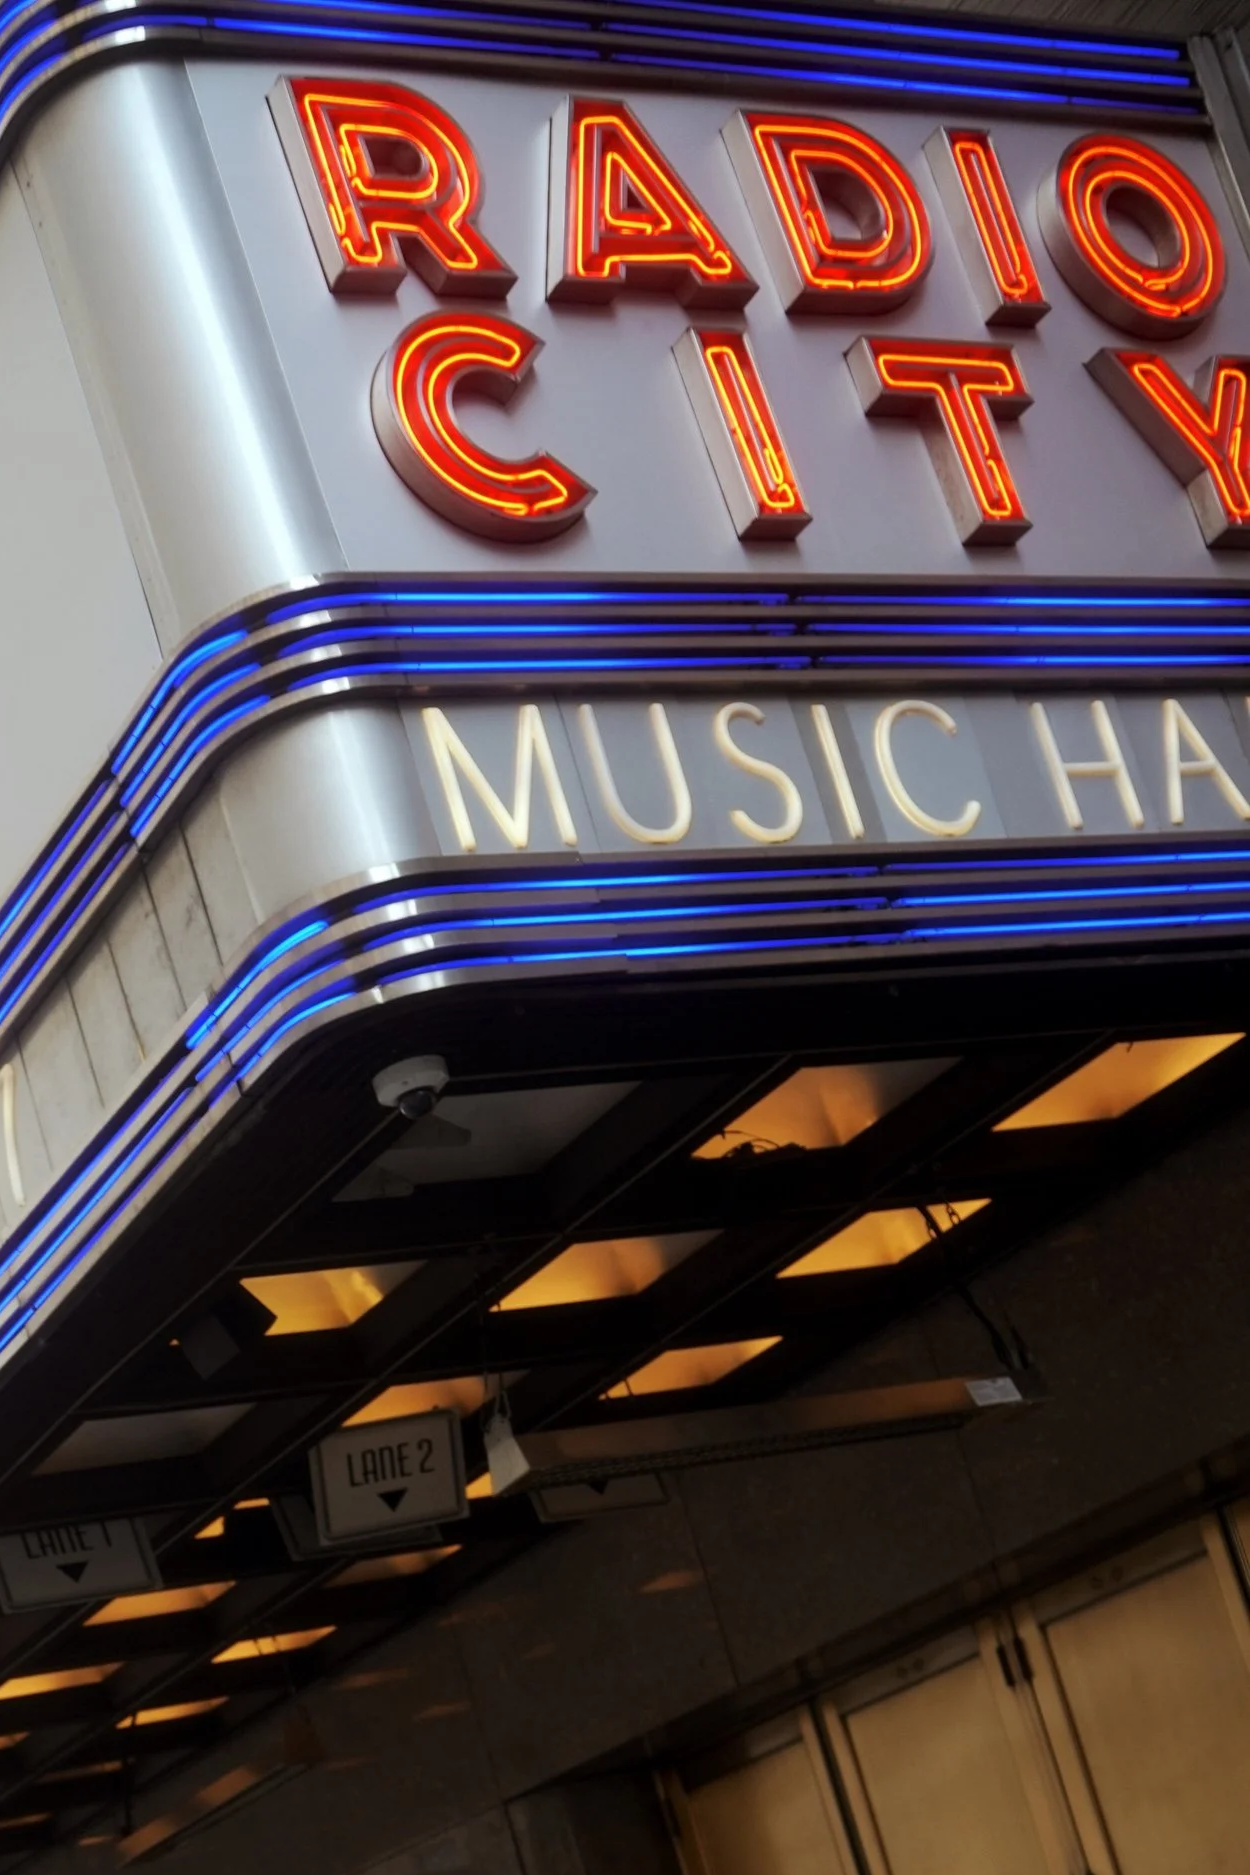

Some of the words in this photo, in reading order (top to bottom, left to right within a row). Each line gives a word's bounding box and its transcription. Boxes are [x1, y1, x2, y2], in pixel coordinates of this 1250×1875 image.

[273, 75, 1227, 330] RADIO
[374, 311, 1250, 540] CITY
[422, 699, 980, 851] MUSIC
[1031, 695, 1250, 831] HA
[345, 1442, 414, 1488] LANE
[417, 1437, 436, 1475] 2
